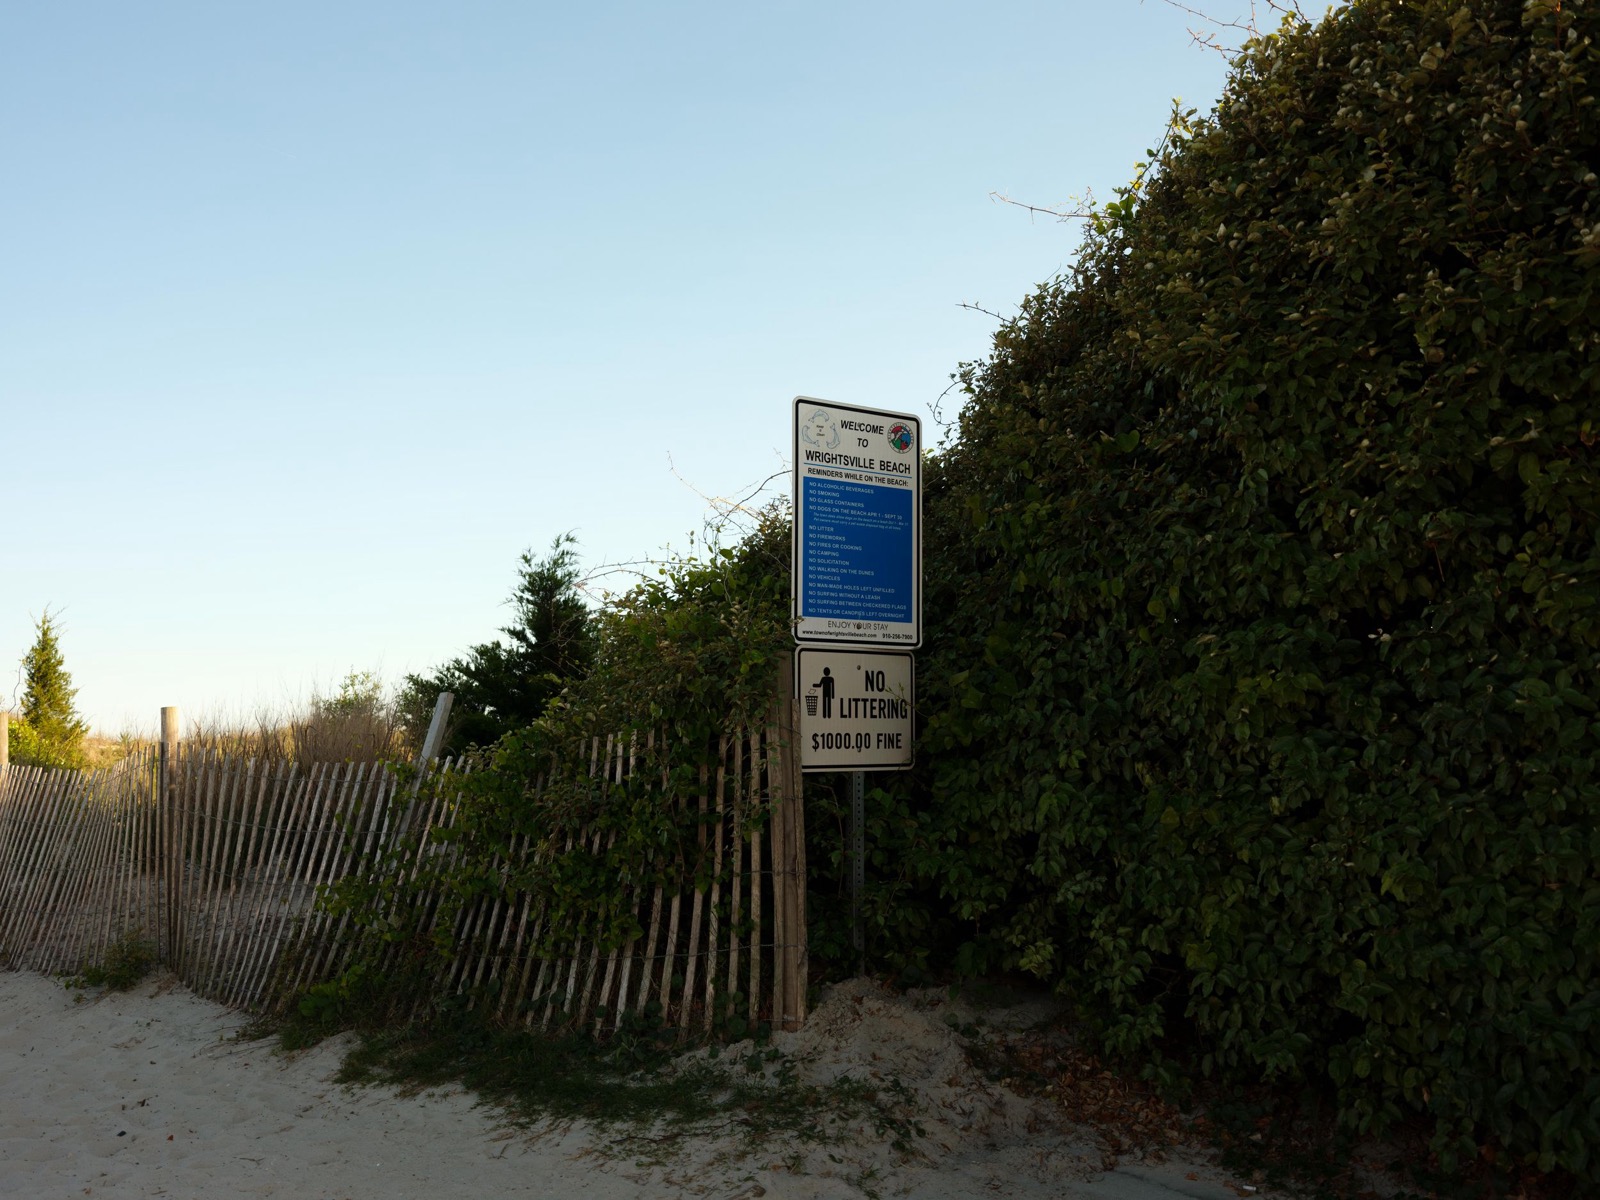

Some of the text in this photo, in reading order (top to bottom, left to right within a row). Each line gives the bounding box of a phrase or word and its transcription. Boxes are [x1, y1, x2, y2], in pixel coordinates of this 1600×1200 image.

[841, 420, 884, 434] WELCOME
[857, 438, 868, 447] TO
[805, 450, 910, 474] WRIGHTSVILLE BEACH
[808, 468, 843, 478] REMINDERS
[844, 473, 862, 481] WHILE
[887, 478, 908, 486] BEACH:
[865, 670, 885, 692] NO
[840, 698, 907, 719] LITTERING
[812, 733, 902, 752] $1000.00 FINE
